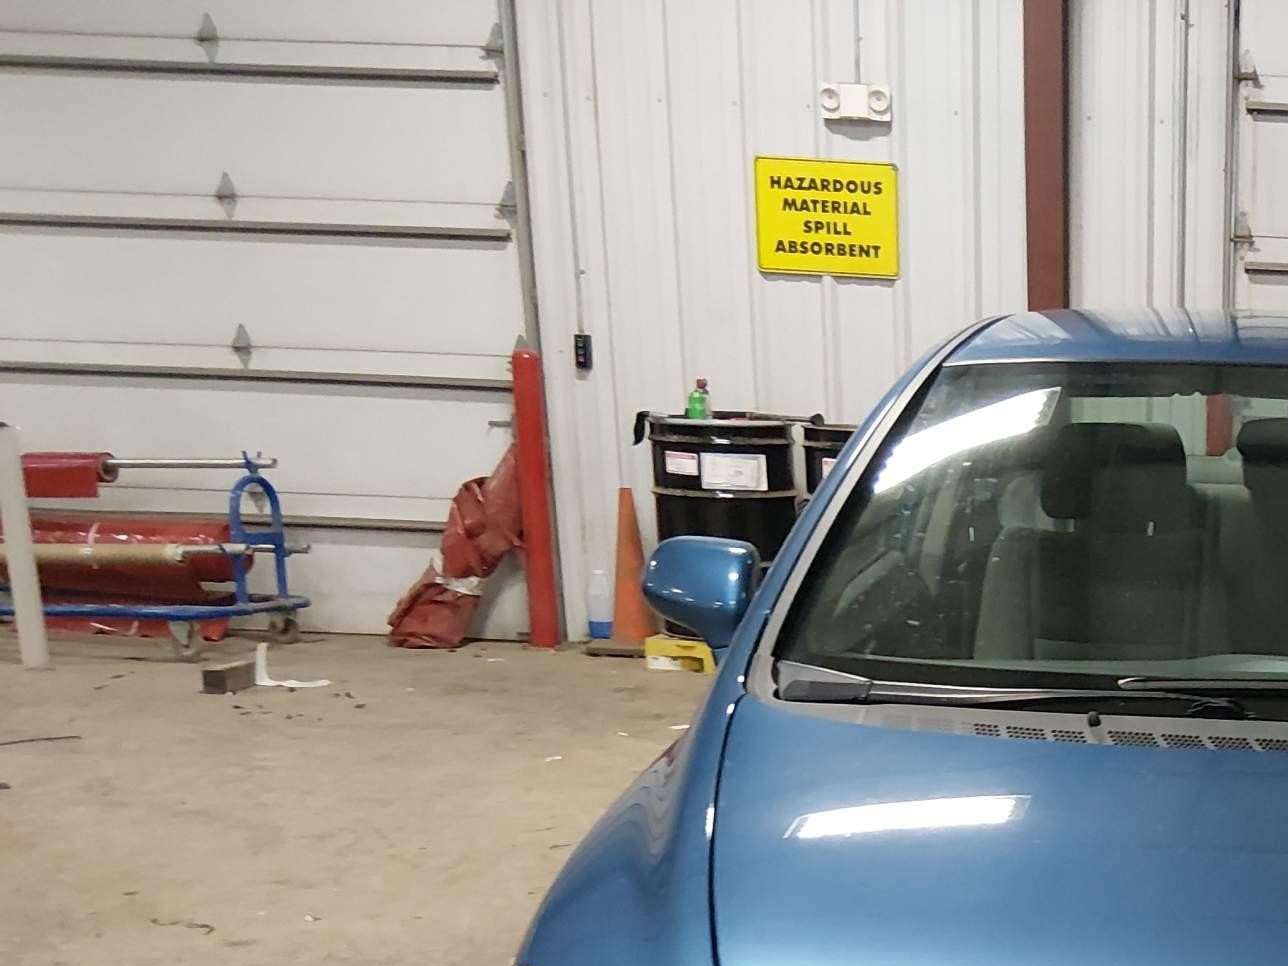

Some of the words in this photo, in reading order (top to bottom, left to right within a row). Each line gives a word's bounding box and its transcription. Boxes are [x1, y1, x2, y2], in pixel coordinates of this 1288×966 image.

[769, 175, 883, 195] HAZARDOUS
[782, 197, 872, 216] MATERIAL
[802, 220, 852, 236] SPILL
[775, 239, 881, 258] ABSORBENT
